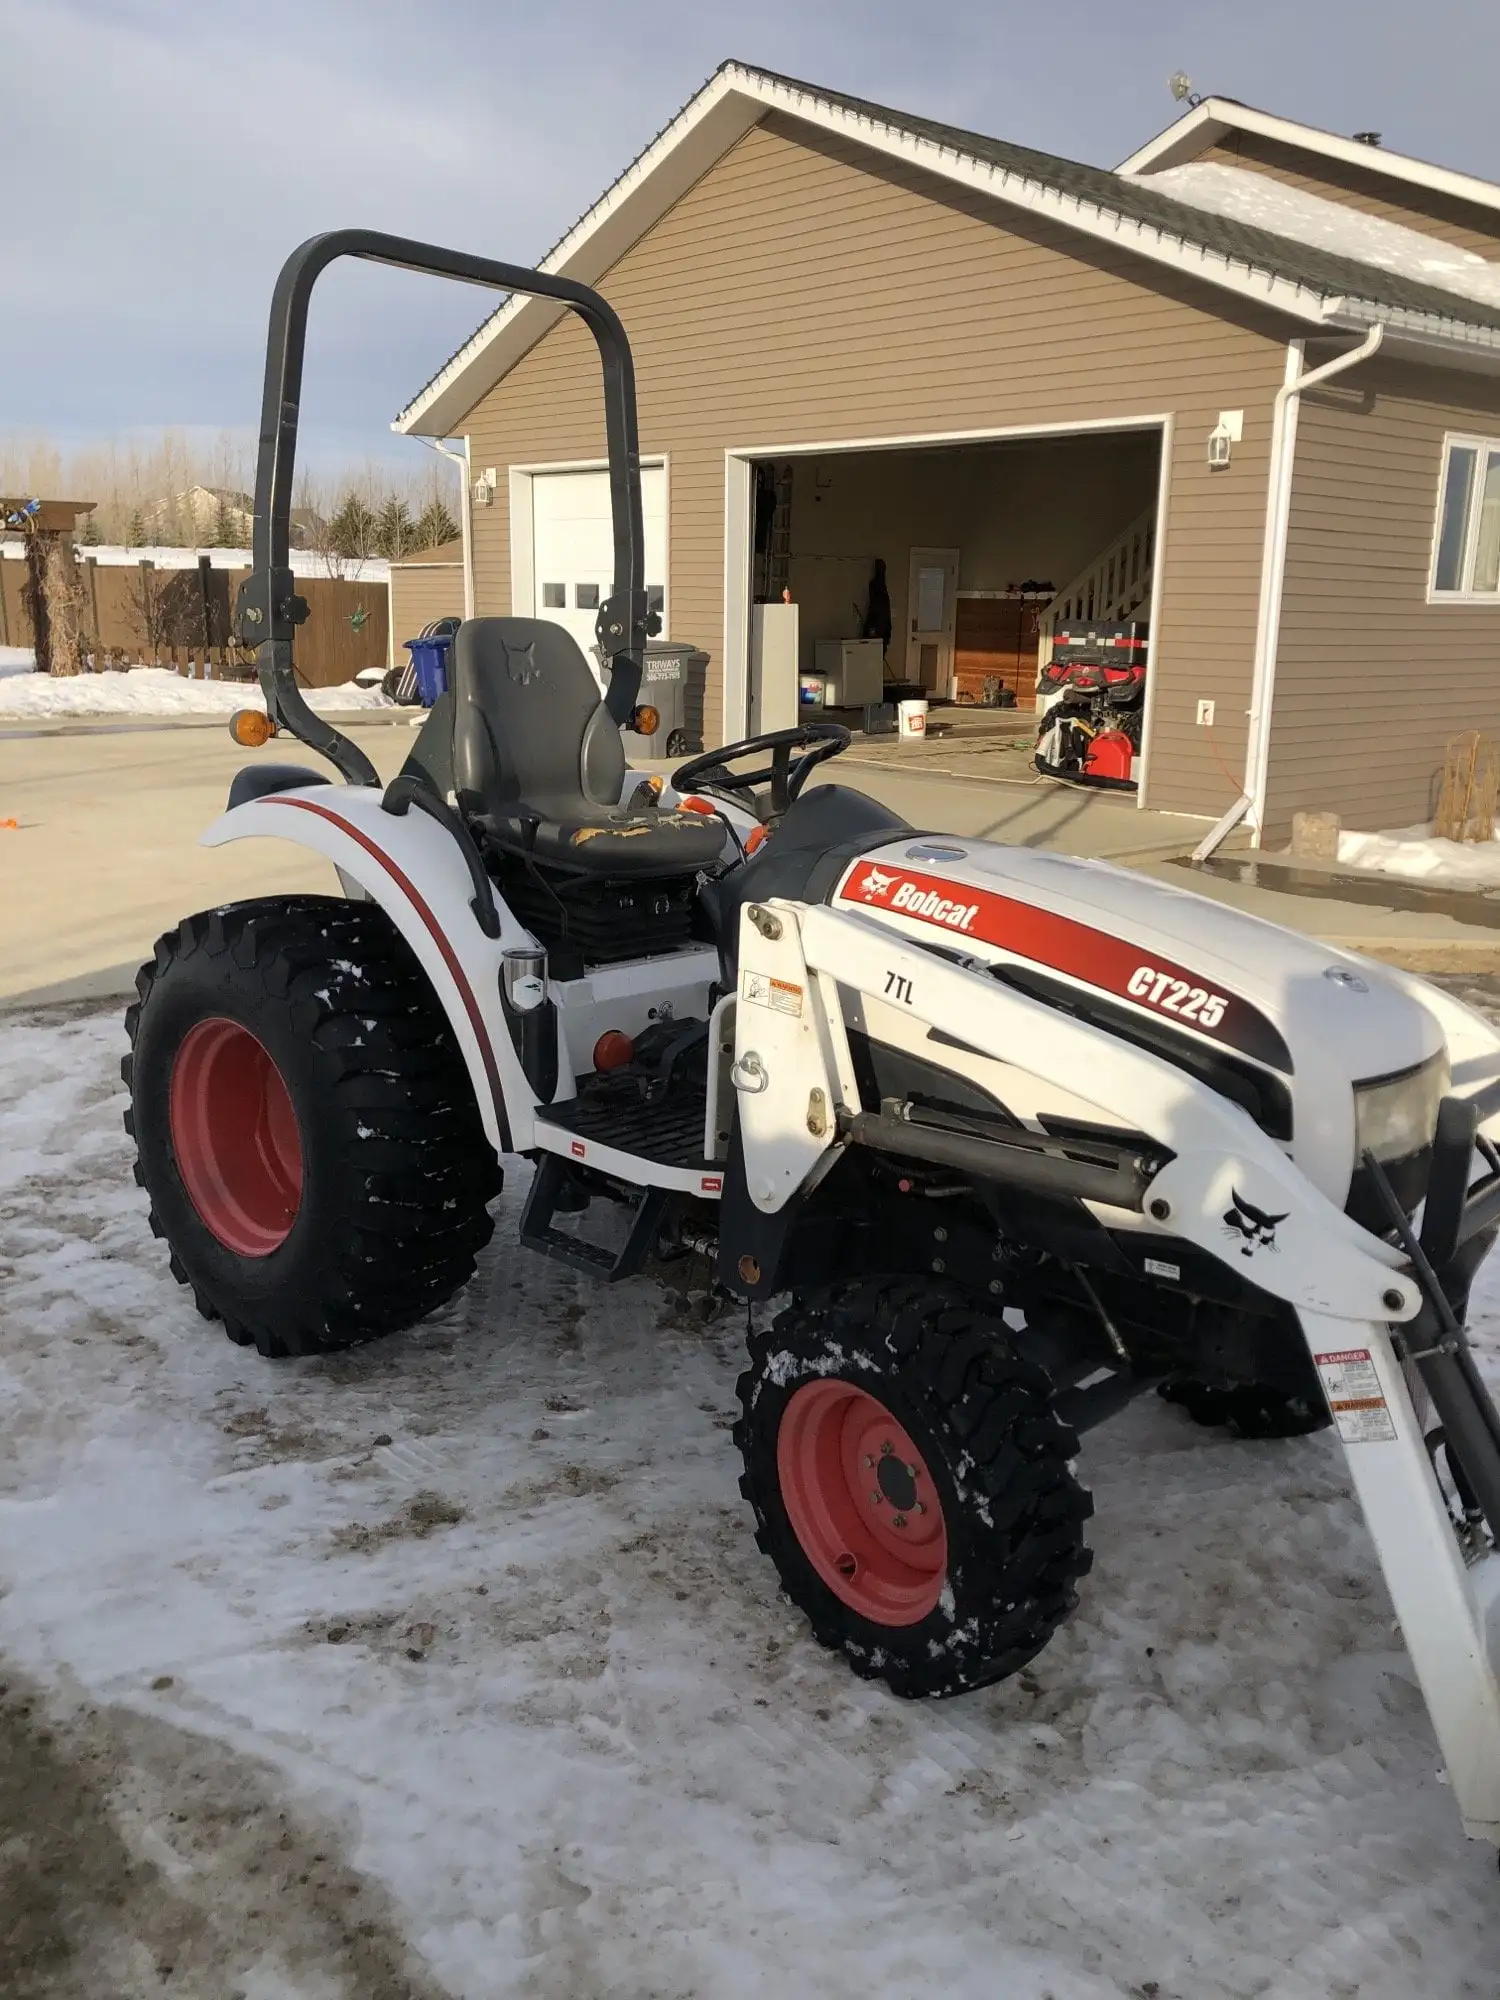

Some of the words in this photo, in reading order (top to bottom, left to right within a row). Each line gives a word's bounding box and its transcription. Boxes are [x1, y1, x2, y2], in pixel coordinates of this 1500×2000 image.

[646, 659, 680, 670] TRIWAYS
[891, 882, 979, 929] Bobcat
[884, 970, 913, 1005] 7TL
[1127, 966, 1229, 1028] CT225
[1329, 1351, 1366, 1362] DANGER
